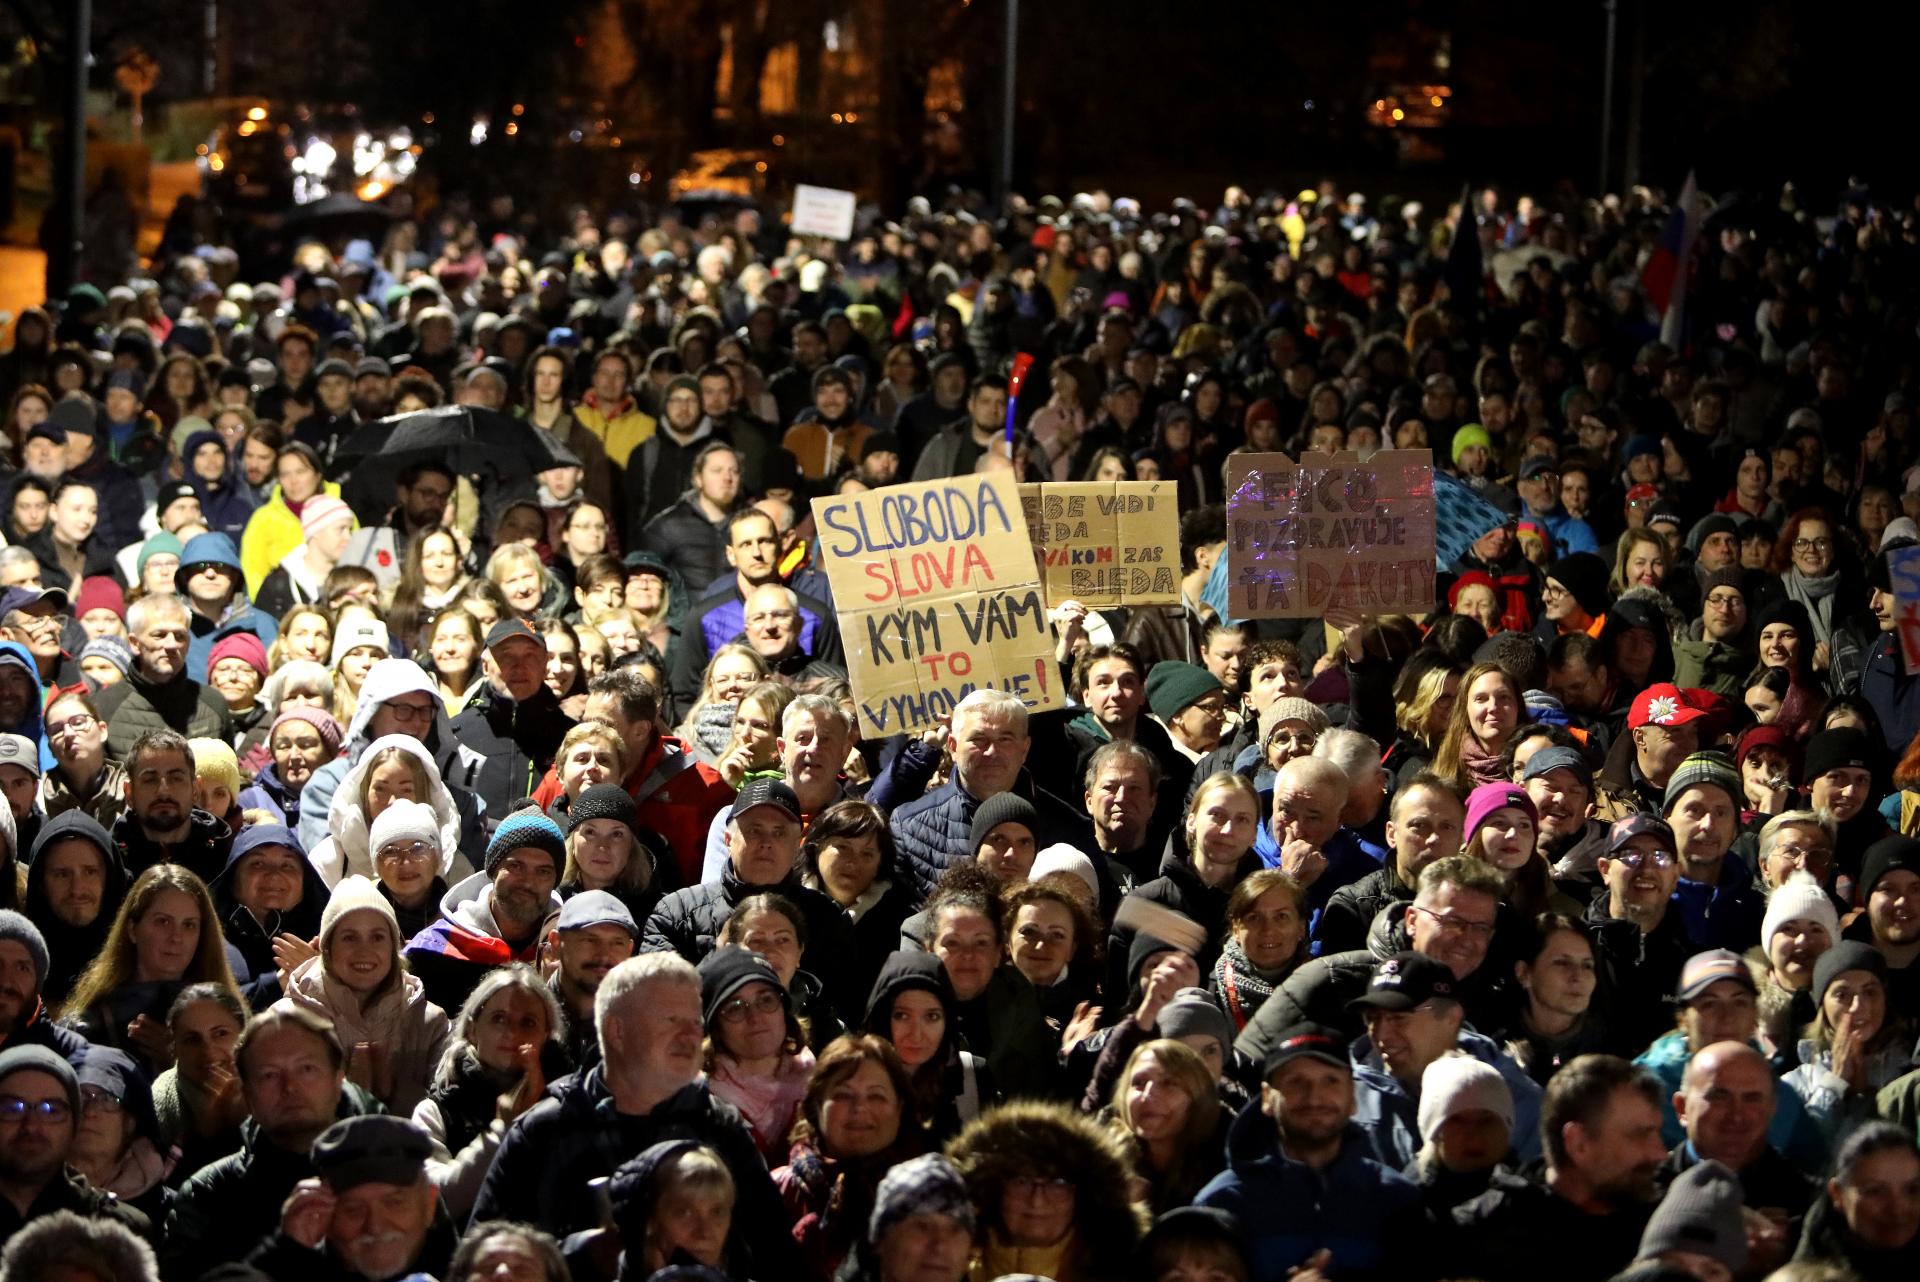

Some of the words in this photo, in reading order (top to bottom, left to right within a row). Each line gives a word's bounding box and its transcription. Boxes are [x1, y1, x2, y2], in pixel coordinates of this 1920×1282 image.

[823, 479, 1012, 558] SLOBODA
[1020, 494, 1087, 520] EBE
[1096, 484, 1160, 517] VADÍ
[1029, 521, 1089, 543] IEDA
[864, 543, 995, 603] SLOVA
[1034, 543, 1113, 568] VÁKOM
[1123, 546, 1164, 565] ZAS
[1071, 566, 1176, 597] BIEDA
[954, 590, 1045, 646] VÁM
[920, 651, 972, 682] TO
[861, 658, 1051, 732] VYHOVE!
